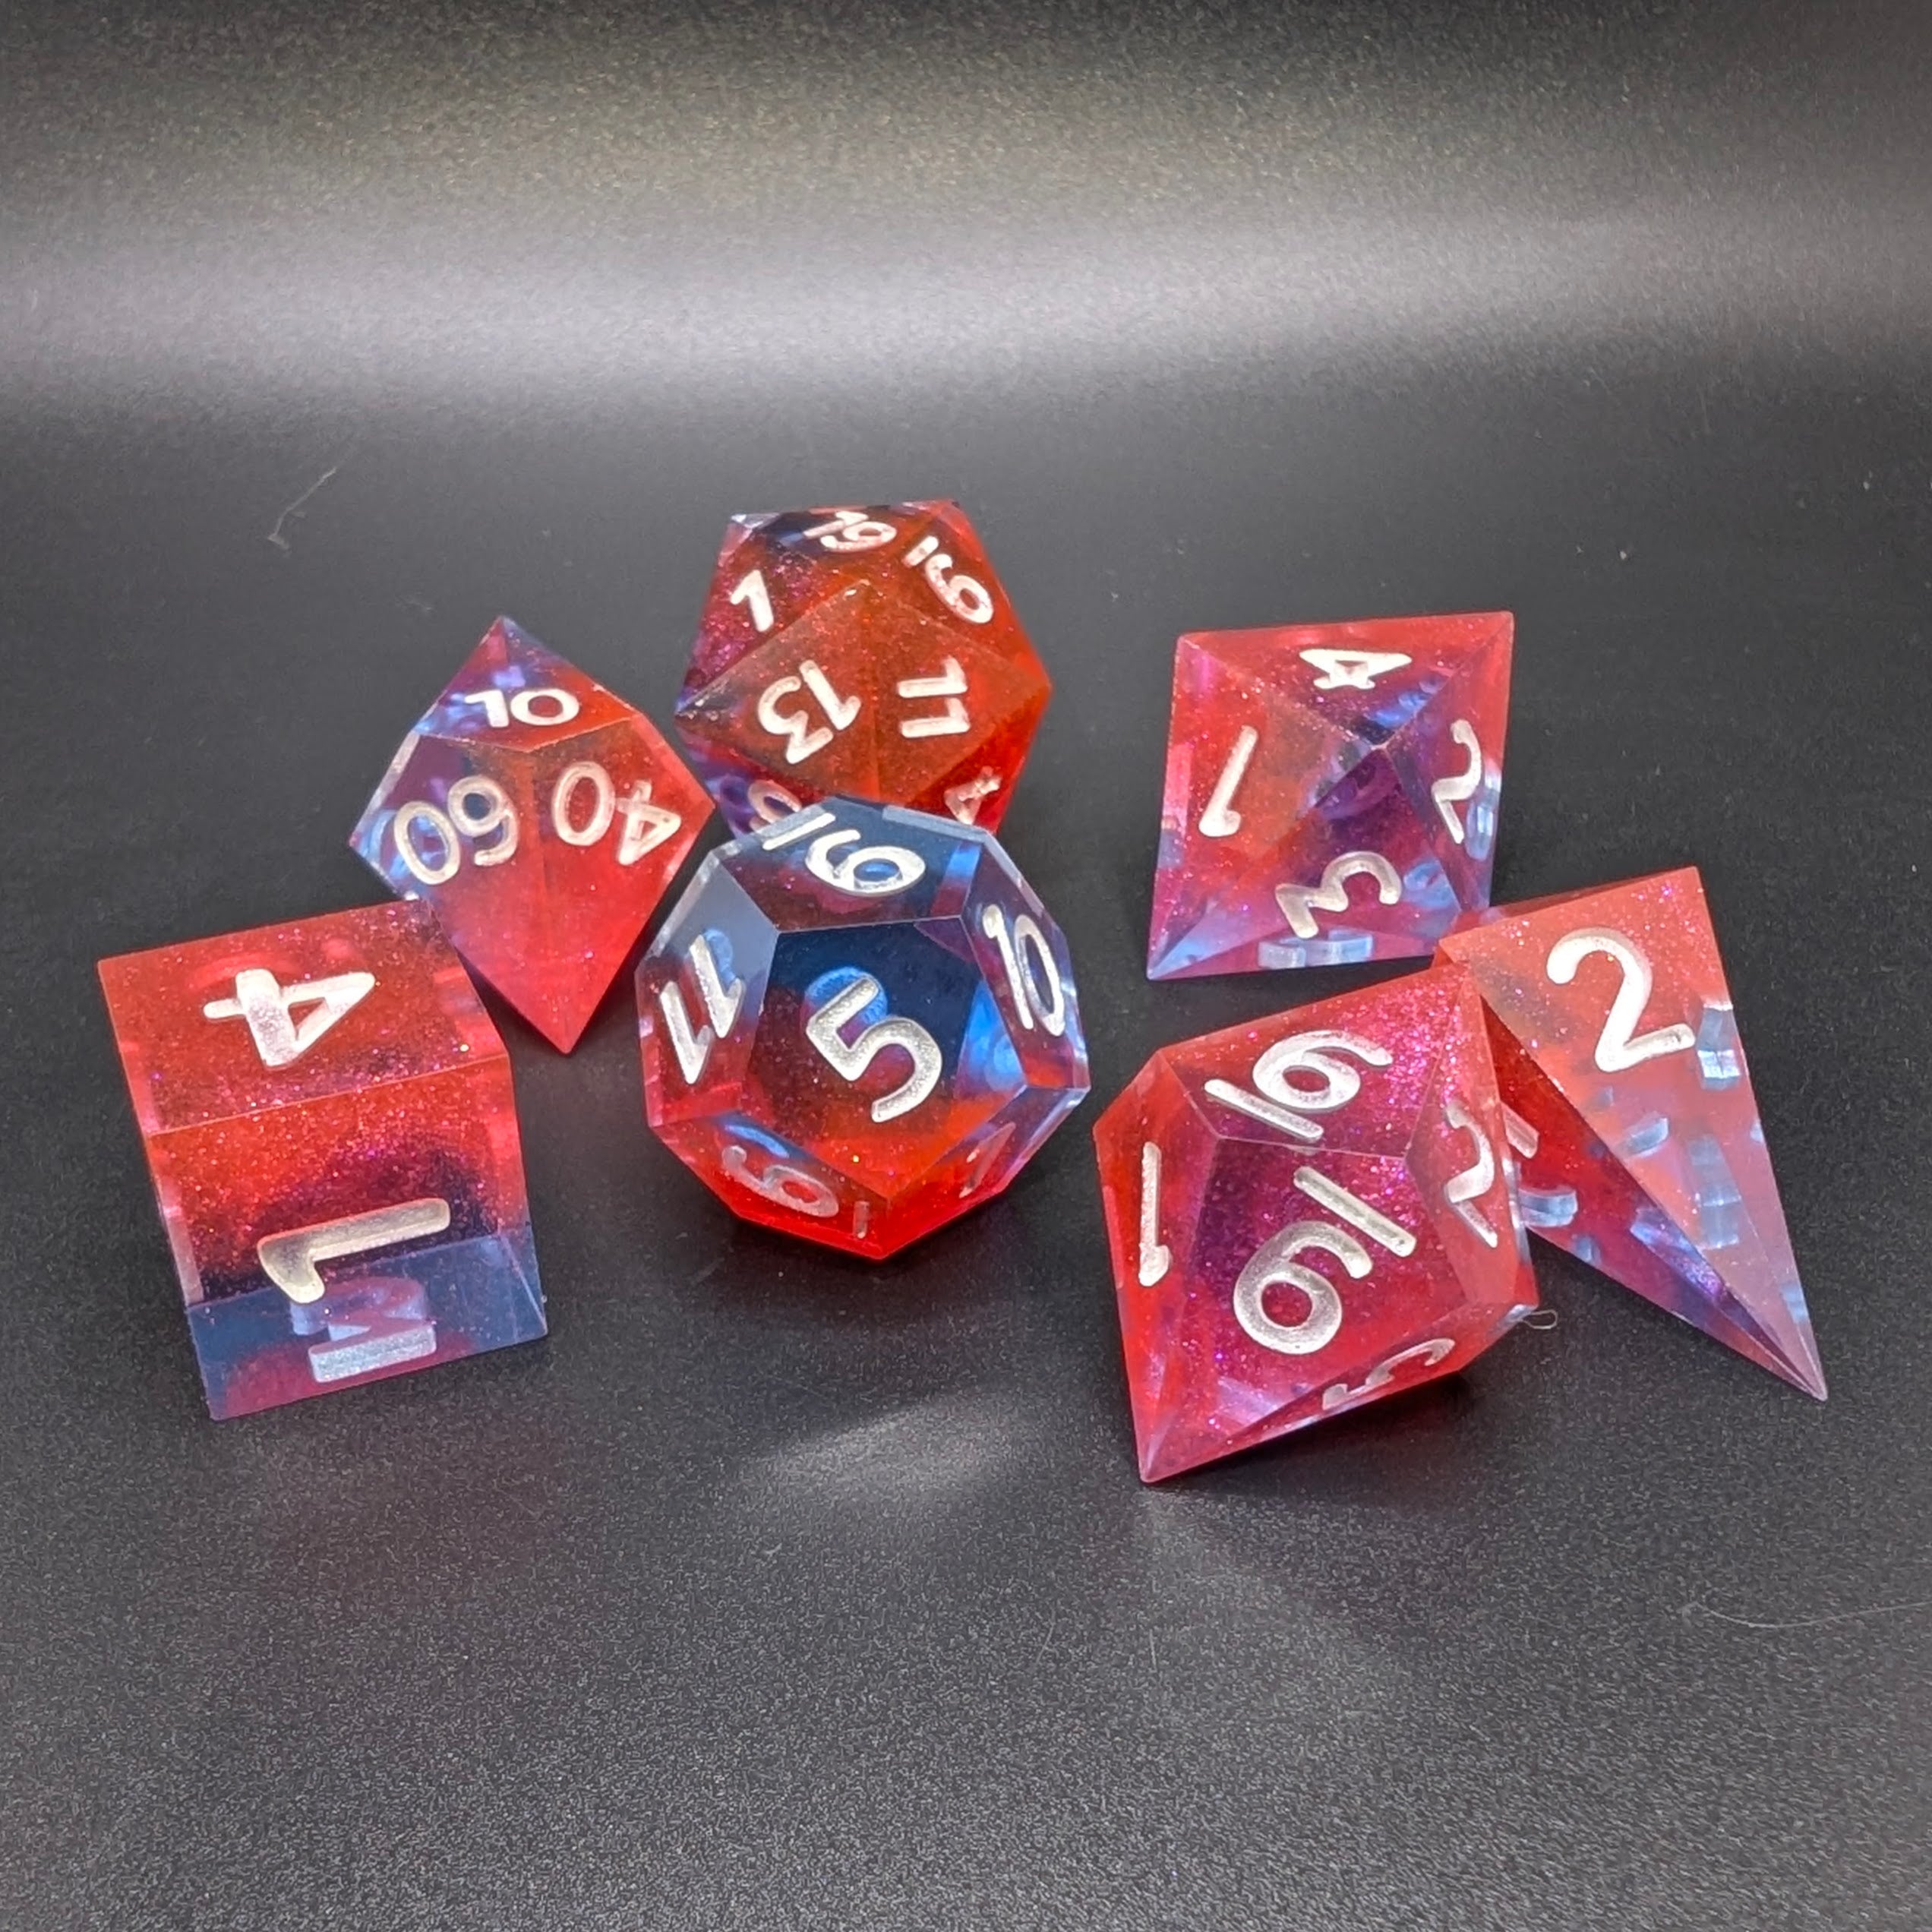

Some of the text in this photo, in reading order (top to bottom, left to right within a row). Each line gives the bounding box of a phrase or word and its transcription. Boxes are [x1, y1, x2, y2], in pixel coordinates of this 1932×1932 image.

[756, 659, 862, 764] 13
[896, 655, 971, 738] 11
[1299, 649, 1413, 690] 4
[1198, 725, 1258, 837] 1
[1432, 719, 1482, 844] 2
[1275, 851, 1402, 939] 3
[203, 968, 376, 1069] 4
[658, 934, 745, 1084] 11
[982, 904, 1065, 1037] 10
[1547, 927, 1696, 1072] 2
[806, 975, 942, 1122] 5
[257, 1198, 450, 1304] 1
[1138, 1141, 1173, 1286] 1
